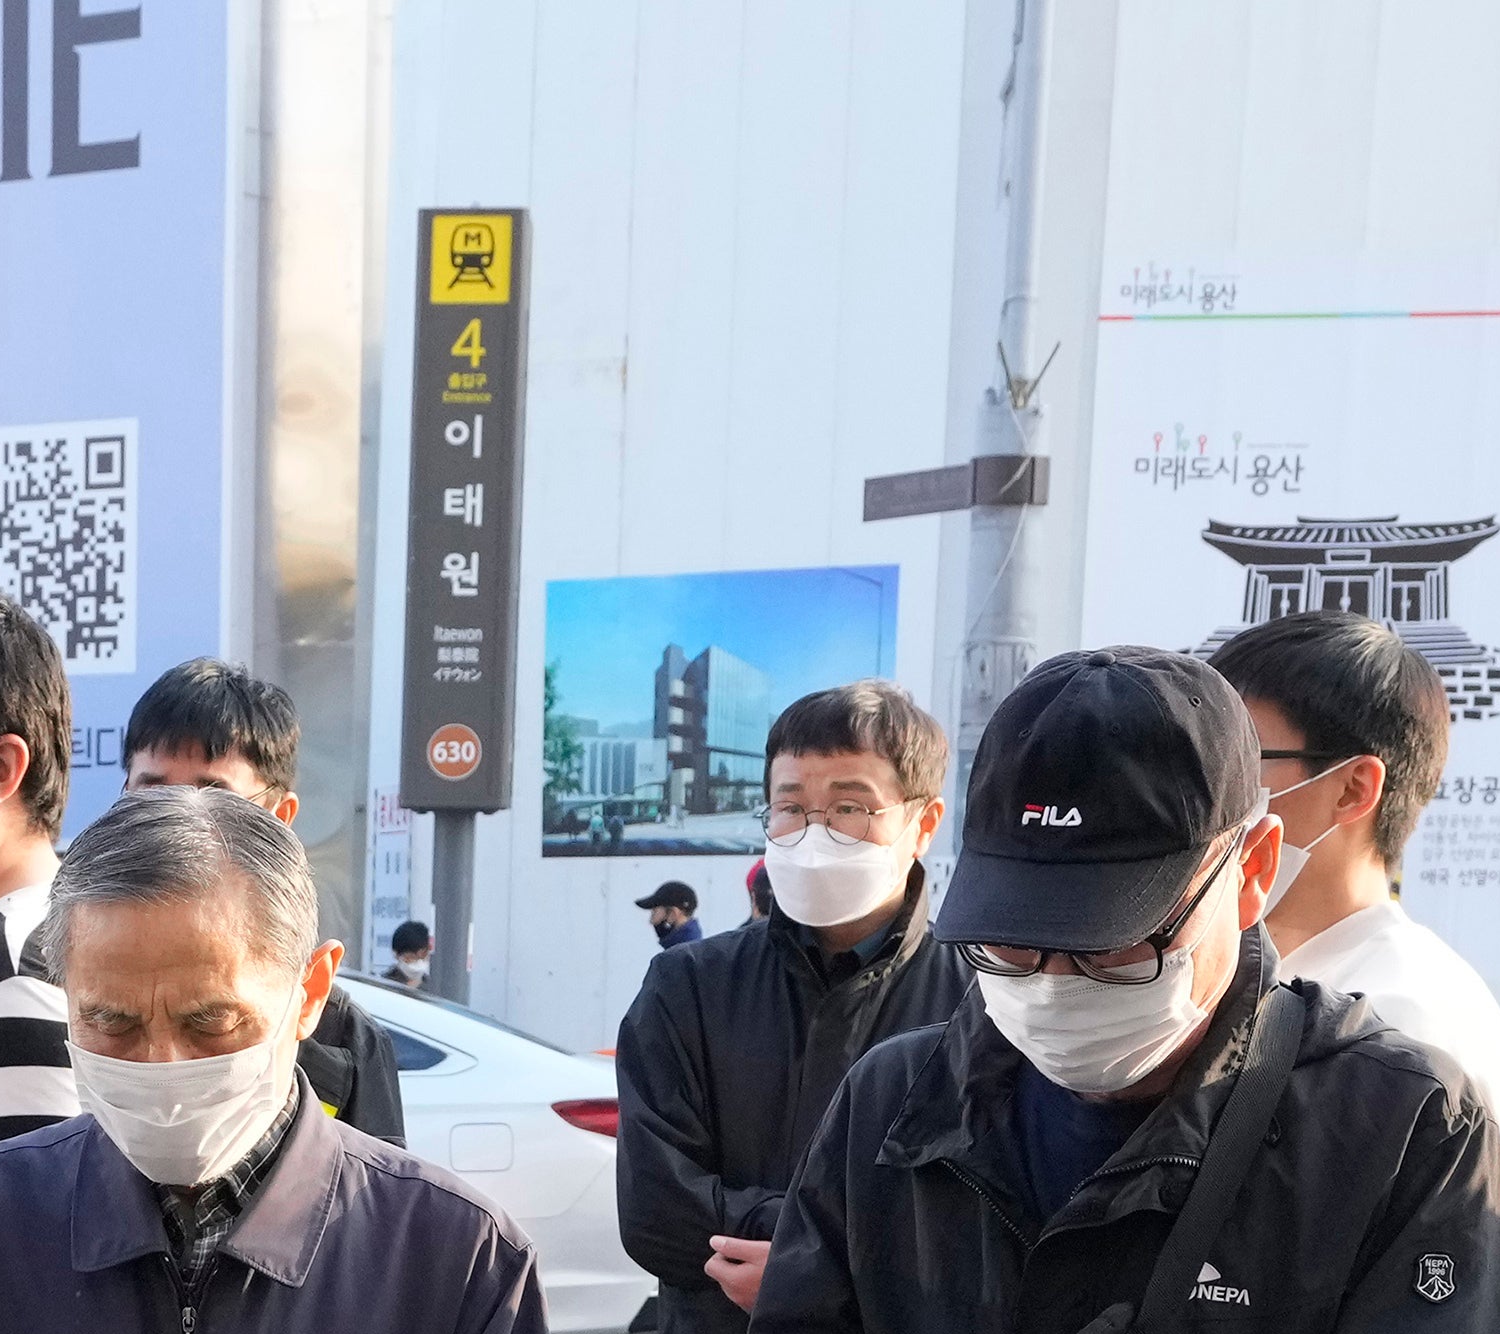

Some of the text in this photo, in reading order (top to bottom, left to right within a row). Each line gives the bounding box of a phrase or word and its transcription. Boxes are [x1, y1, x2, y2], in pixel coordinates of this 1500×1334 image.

[1197, 281, 1237, 313] 용산
[450, 316, 487, 369] 4
[1134, 453, 1306, 497] 미래도시 용산
[431, 740, 476, 763] 630
[1021, 803, 1083, 828] FILA
[1197, 1282, 1251, 1307] NEPA
